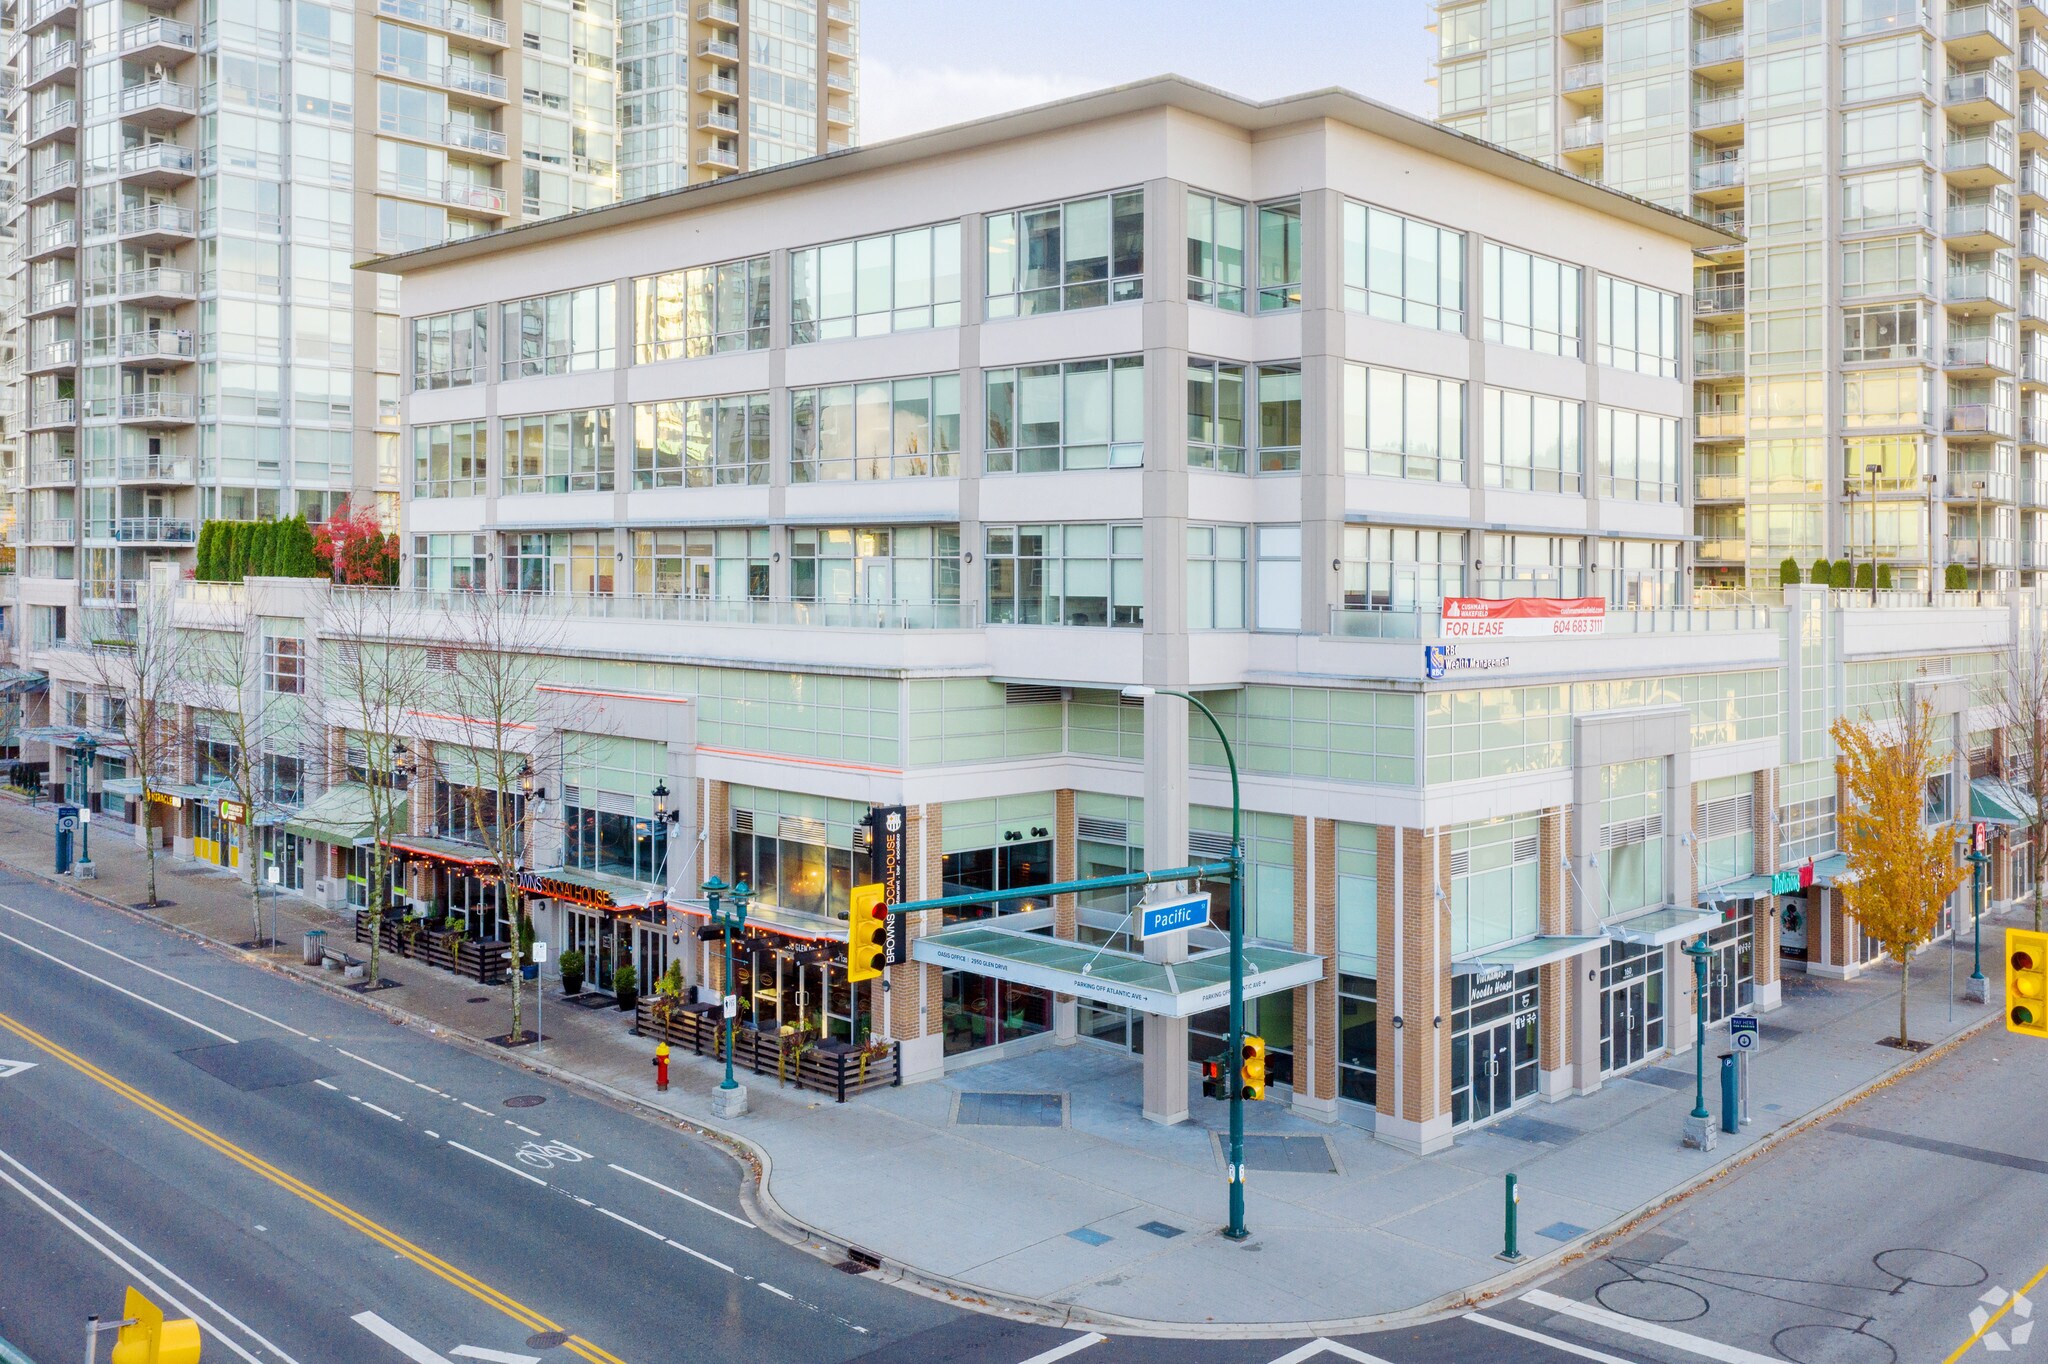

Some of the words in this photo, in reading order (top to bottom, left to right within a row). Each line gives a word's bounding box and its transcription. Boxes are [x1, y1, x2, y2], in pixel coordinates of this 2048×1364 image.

[1445, 621, 1469, 636] FOR
[1471, 621, 1504, 636] LEASE
[1553, 620, 1571, 634] 604
[1572, 619, 1588, 633] 683
[1589, 618, 1603, 633] 3111
[1445, 644, 1459, 656] RBC
[1445, 657, 1470, 670] Wealth
[1470, 656, 1511, 670] Management
[1431, 668, 1444, 676] RBC
[1154, 907, 1192, 928] Pacific
[886, 913, 896, 964] BROWNS
[937, 951, 951, 959] OASIS
[951, 953, 966, 962] OFFICE
[971, 958, 983, 966] 2950
[983, 960, 995, 968] GLEN
[995, 963, 1008, 972] DRIVE
[1074, 980, 1096, 990] PARKING
[1106, 987, 1132, 998] ATLANTIC
[1131, 993, 1142, 1001] AVE
[1202, 991, 1222, 1001] PARKING
[1471, 984, 1494, 1001] Noodle
[1494, 980, 1512, 994] House
